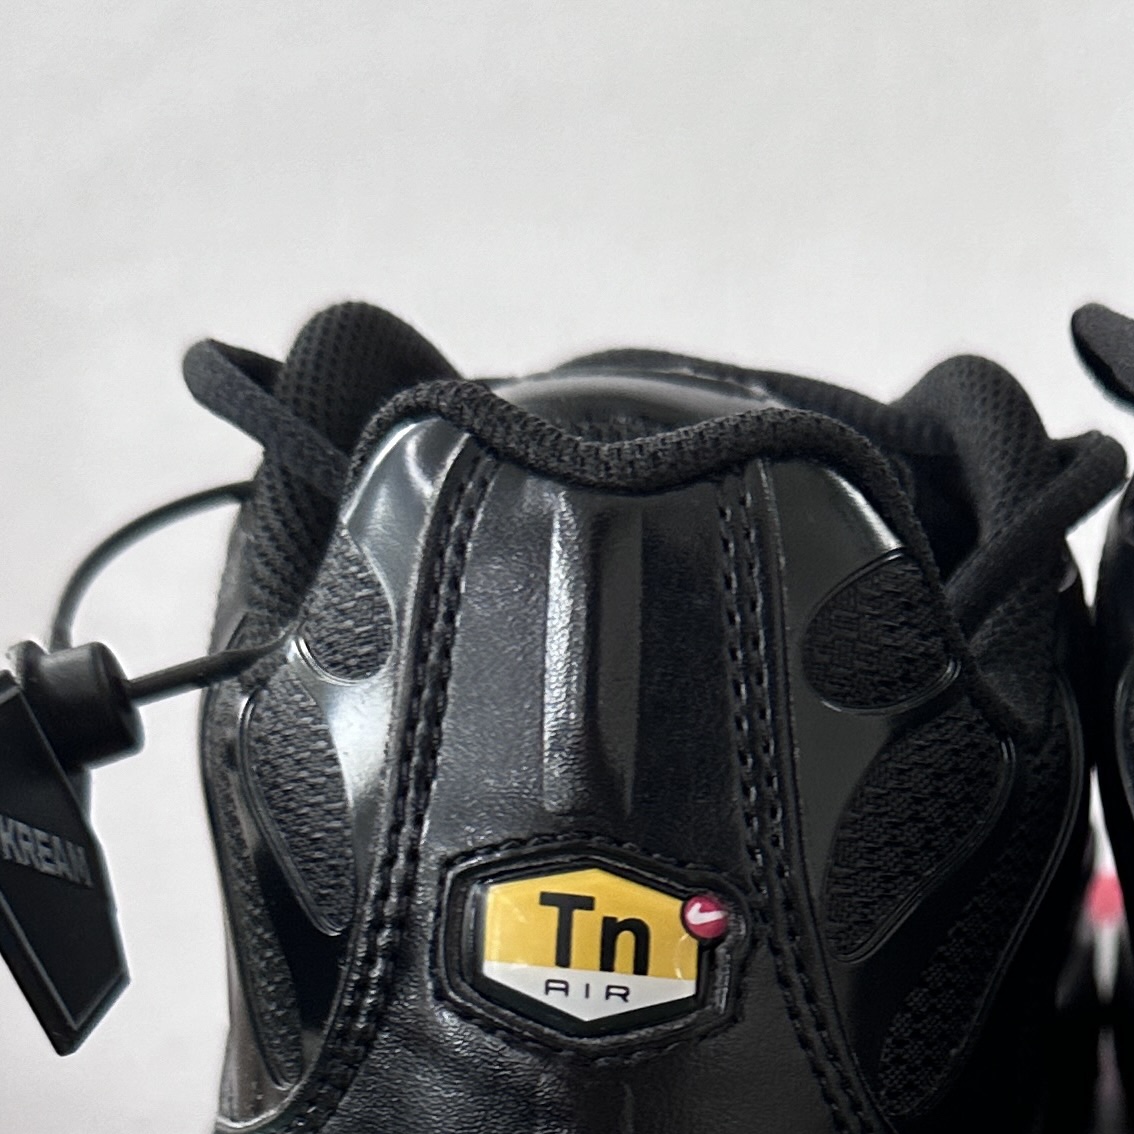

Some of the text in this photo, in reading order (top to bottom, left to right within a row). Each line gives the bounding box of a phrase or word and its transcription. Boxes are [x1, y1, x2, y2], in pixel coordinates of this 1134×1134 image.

[0, 814, 95, 889] KREAM
[539, 890, 651, 976] Tn
[544, 978, 630, 1003] AIR
